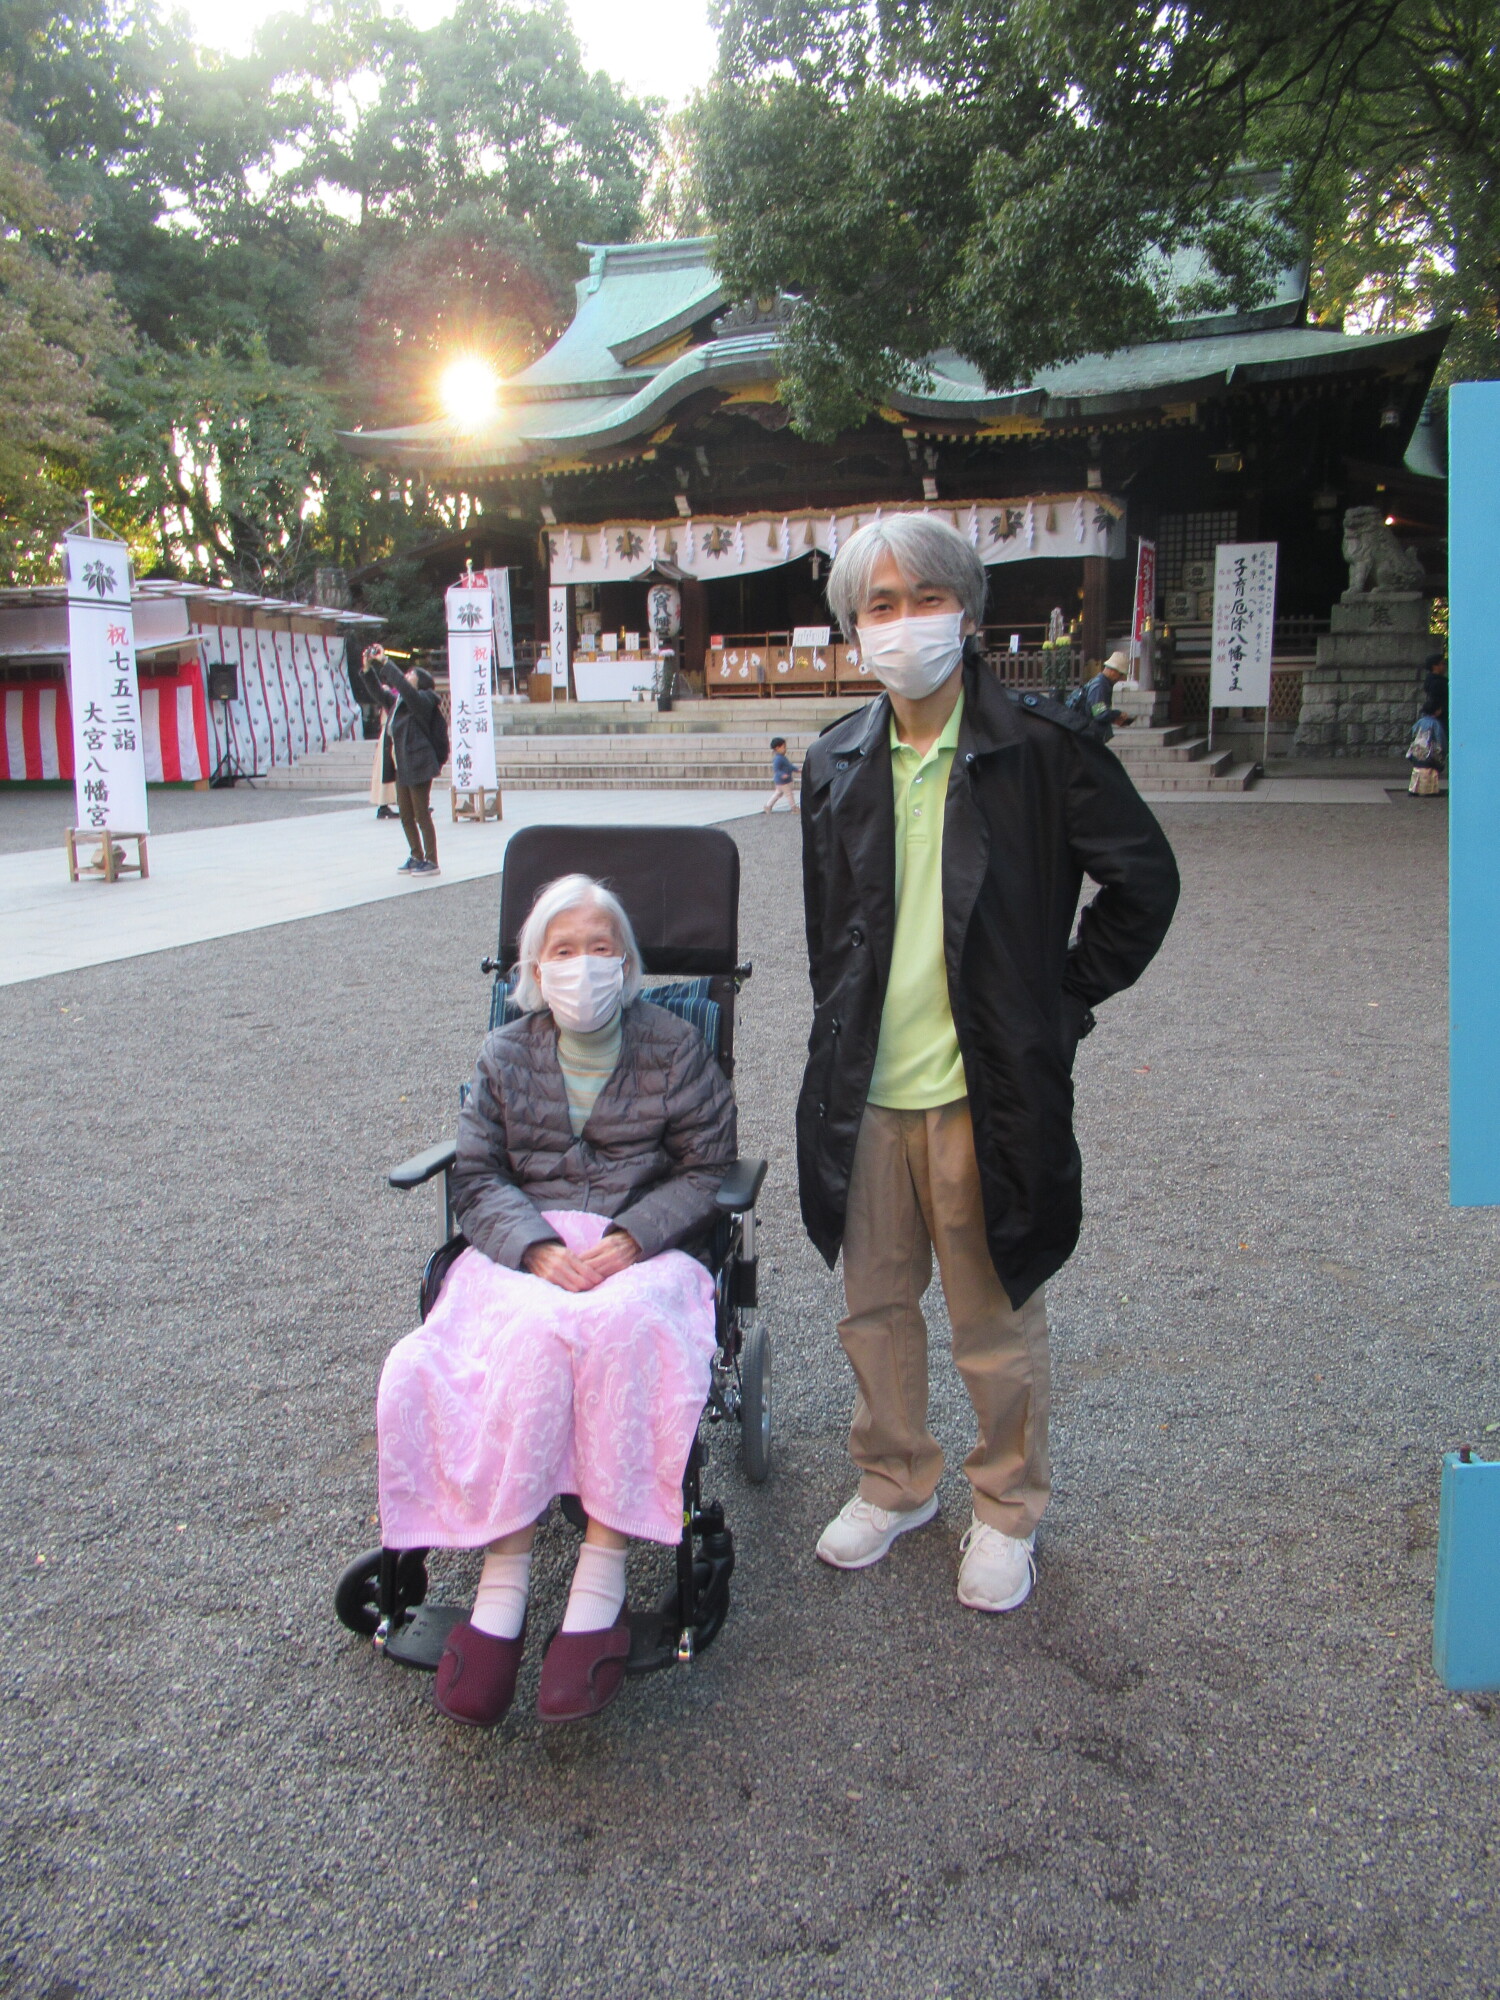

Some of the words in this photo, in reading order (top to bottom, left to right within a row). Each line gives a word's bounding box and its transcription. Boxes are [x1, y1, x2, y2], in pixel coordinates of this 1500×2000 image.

[553, 600, 564, 675] おみくじ
[1228, 557, 1248, 692] 子育厄除八幡さま
[82, 701, 110, 827] 大宮八幡宮
[456, 700, 473, 787] 大宮八幡宮
